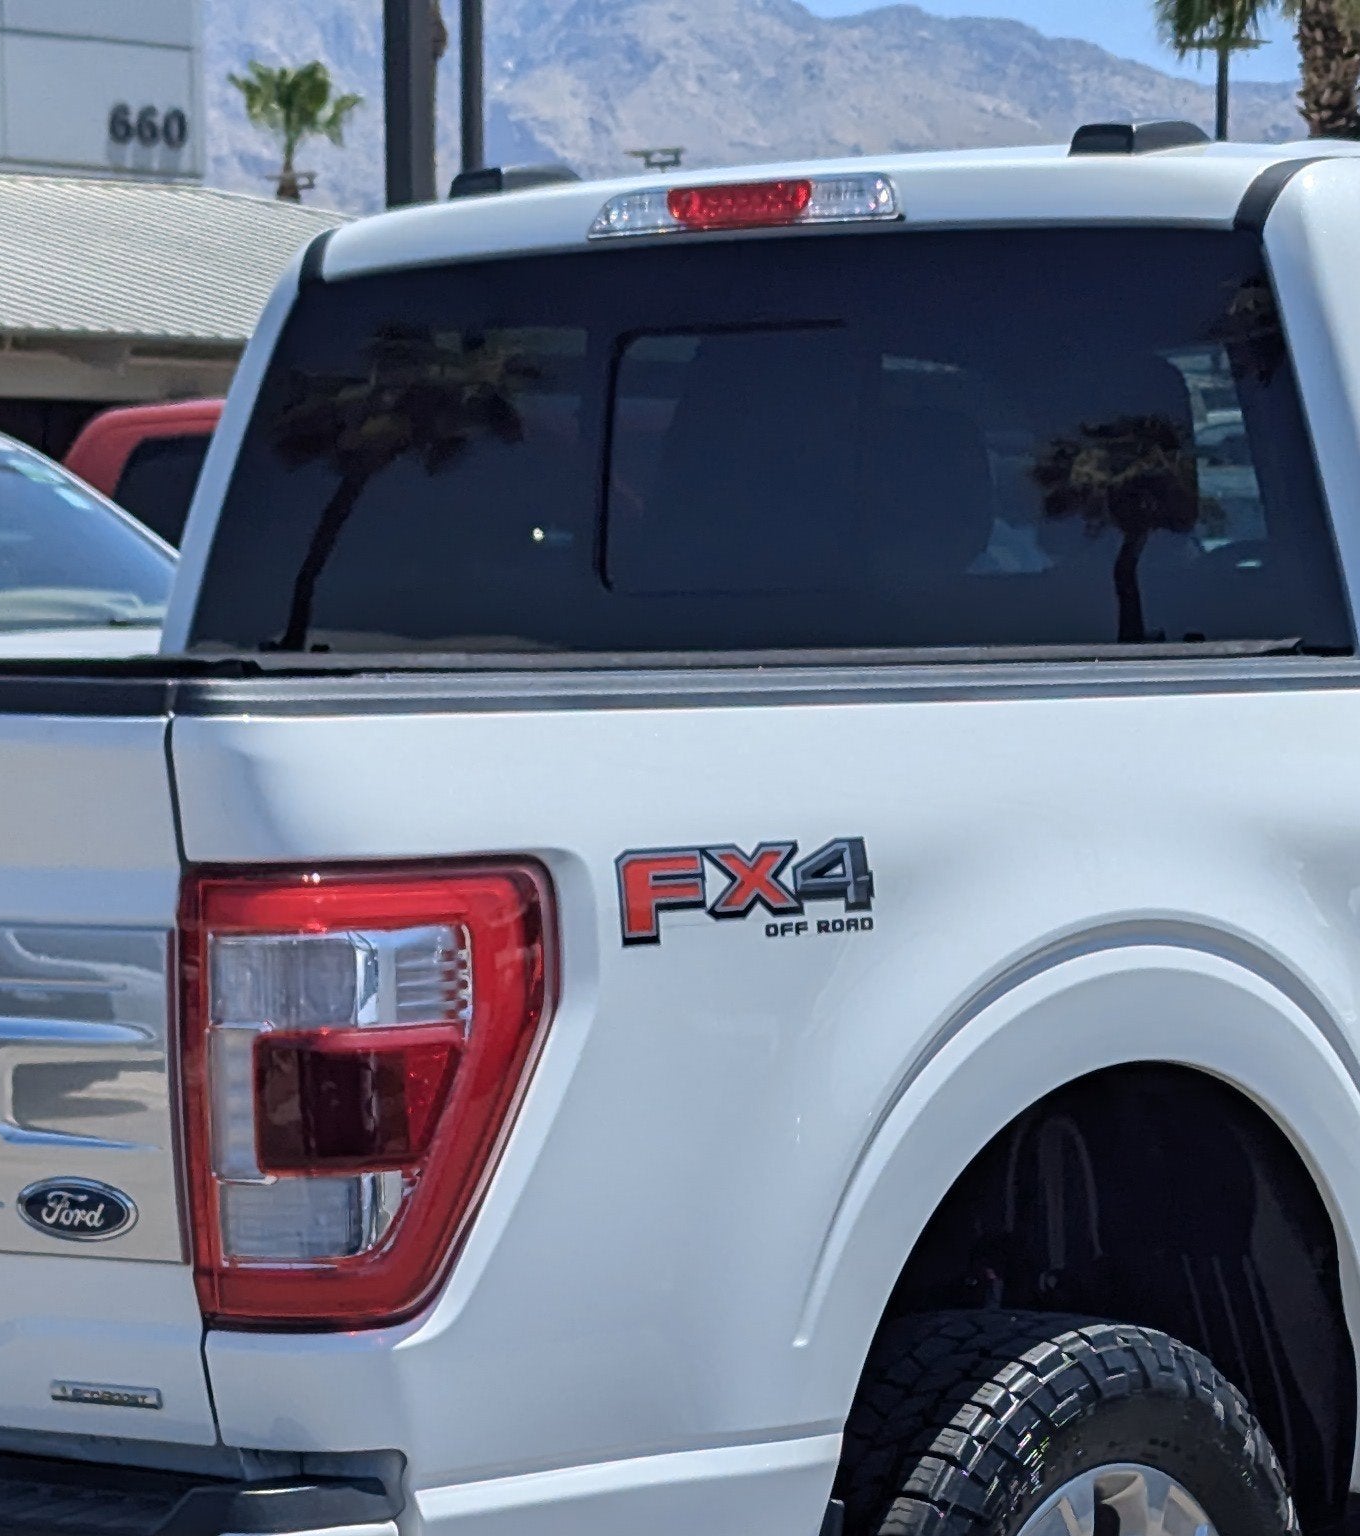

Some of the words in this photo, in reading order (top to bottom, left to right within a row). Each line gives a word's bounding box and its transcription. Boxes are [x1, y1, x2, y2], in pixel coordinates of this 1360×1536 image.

[108, 103, 187, 149] 660
[615, 836, 874, 948] FX4
[765, 920, 809, 937] OFF
[817, 916, 874, 936] ROAD
[41, 1190, 105, 1228] Ford
